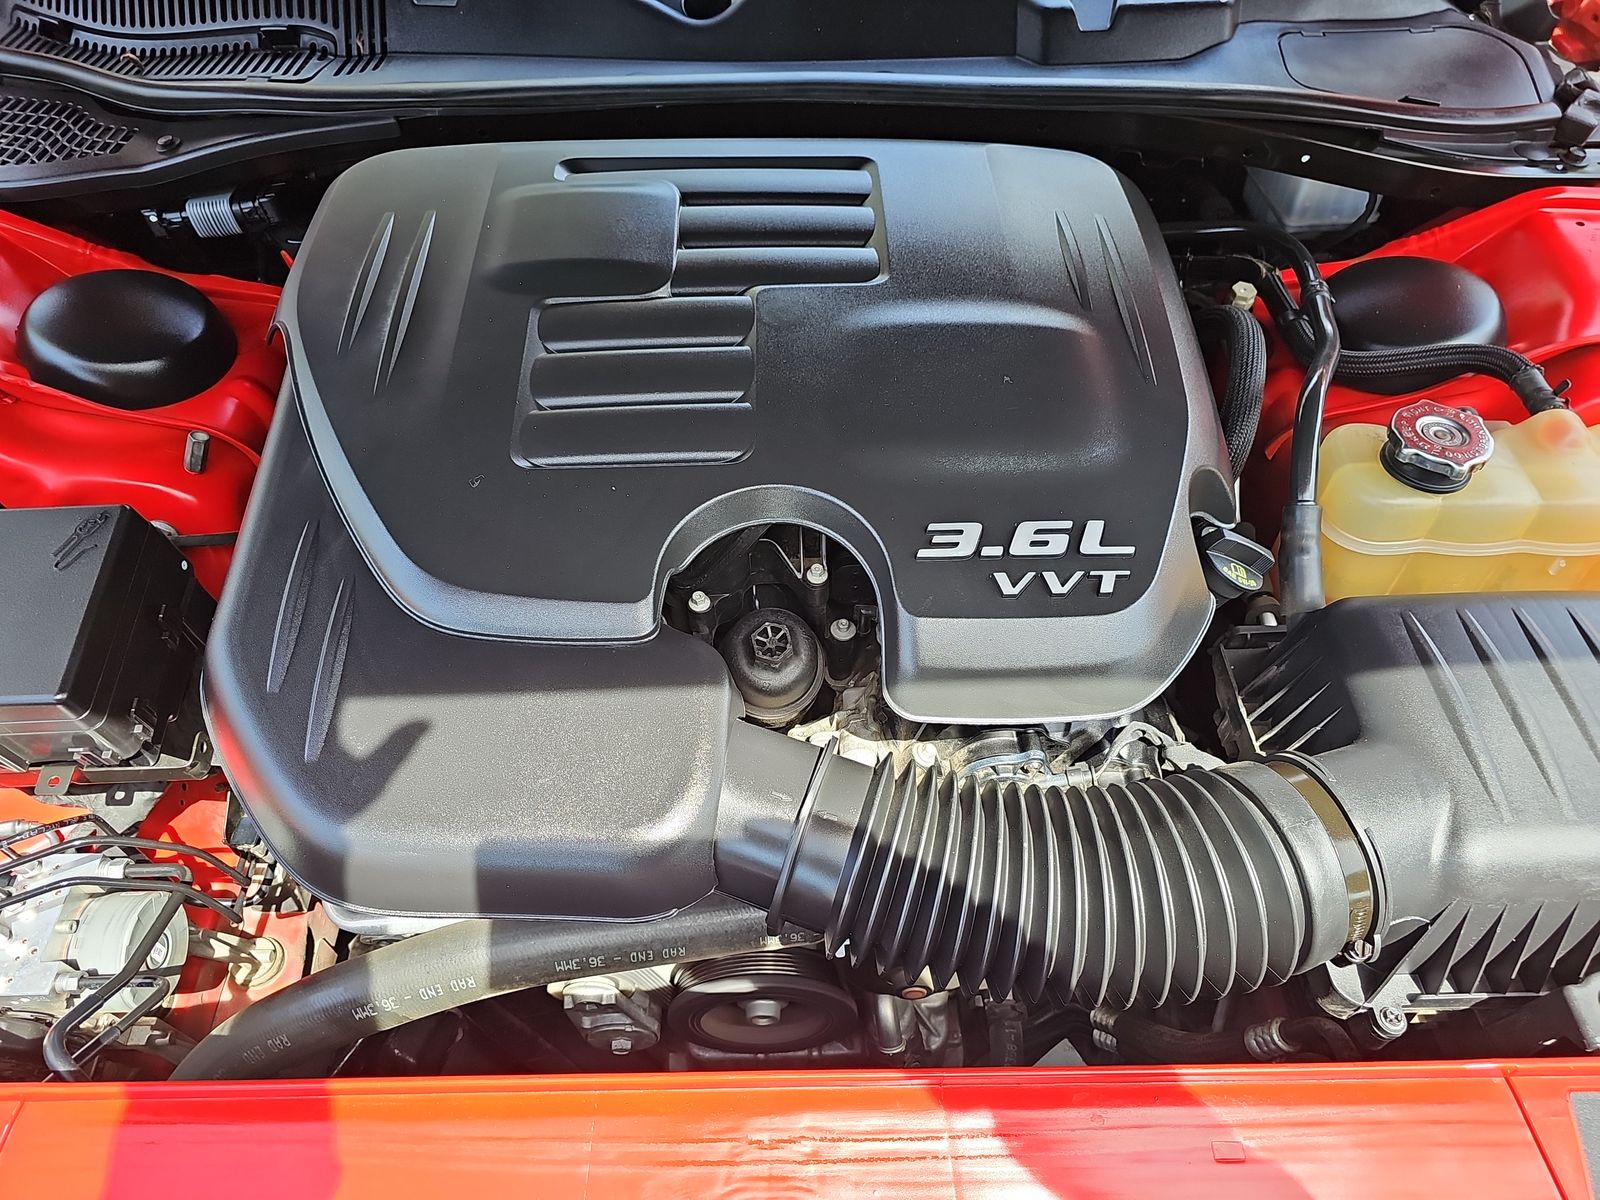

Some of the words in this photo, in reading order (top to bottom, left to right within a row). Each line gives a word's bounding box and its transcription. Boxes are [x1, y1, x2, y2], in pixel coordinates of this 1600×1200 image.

[915, 520, 1136, 560] 3.6L
[991, 570, 1131, 599] VVT
[630, 950, 654, 963] END
[662, 946, 687, 959] RAD
[554, 955, 606, 972] 36.3MM
[419, 984, 444, 1000] END
[449, 976, 476, 992] RAD
[351, 996, 400, 1021] 36.3MM
[266, 1033, 292, 1053] RAD
